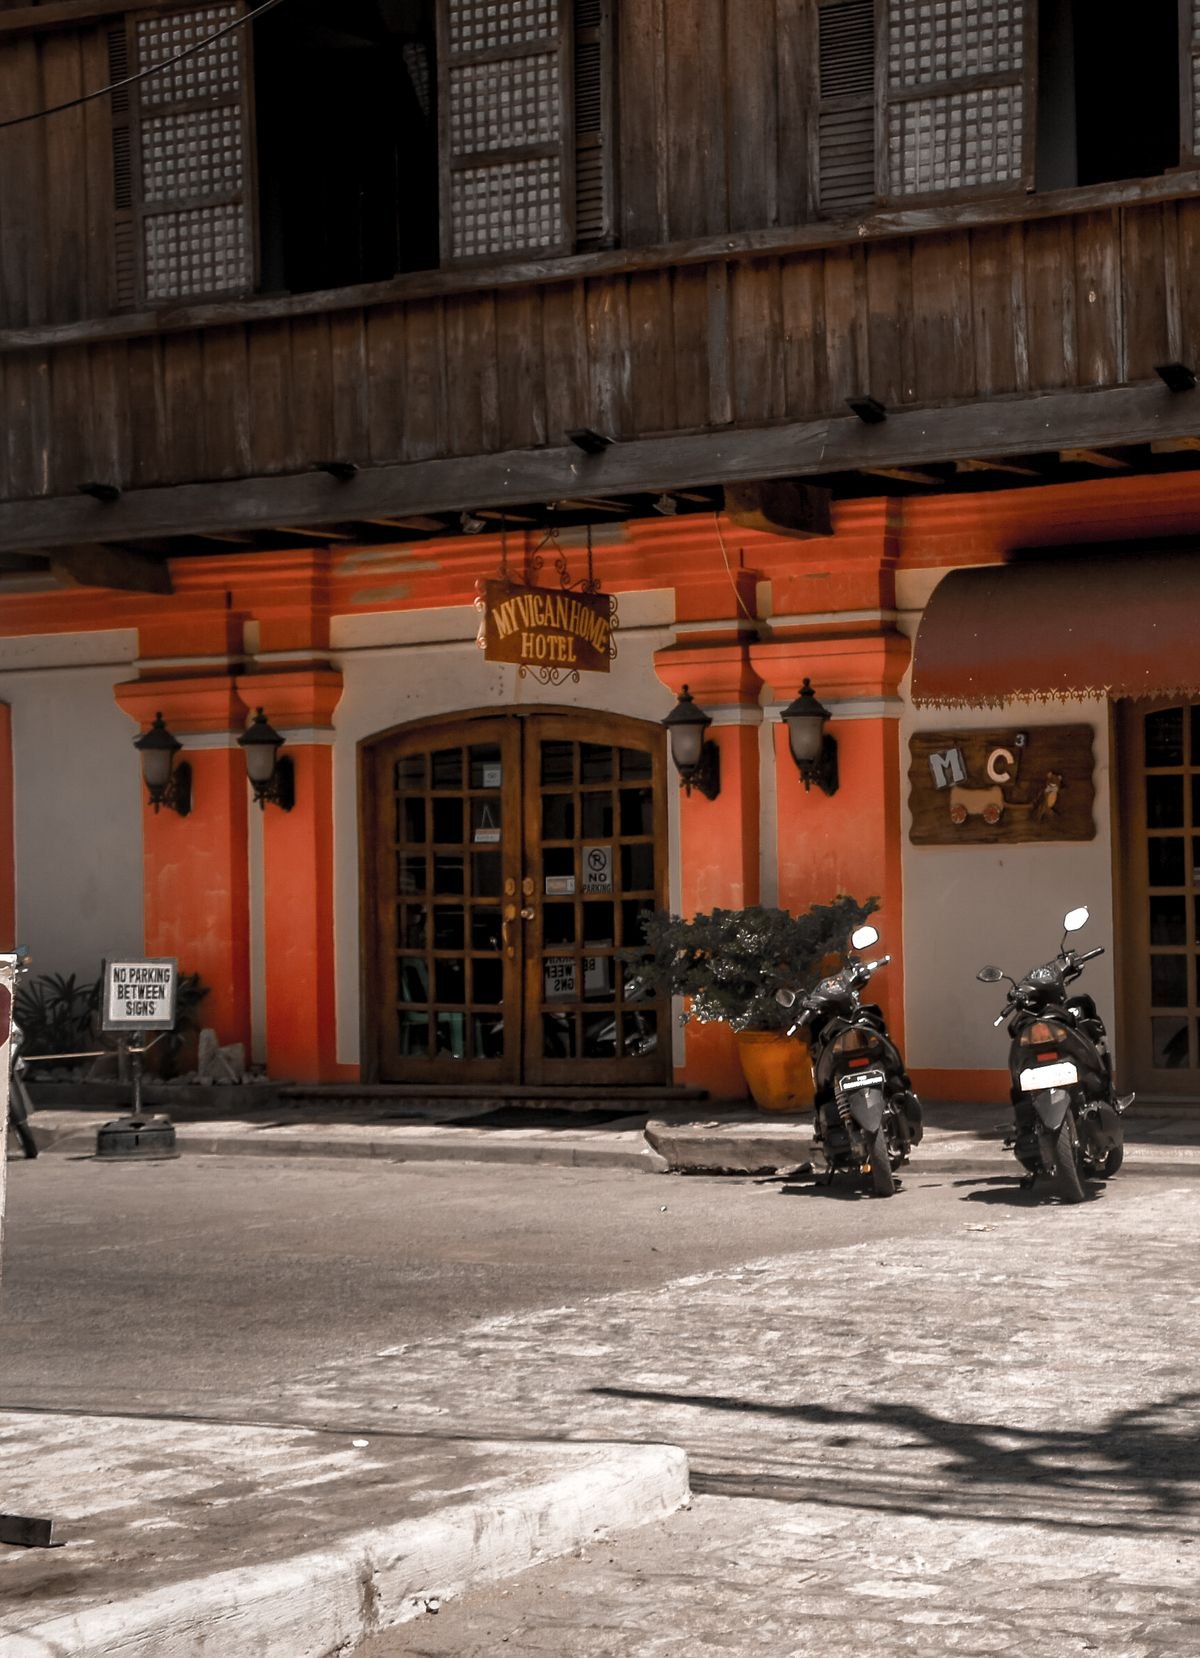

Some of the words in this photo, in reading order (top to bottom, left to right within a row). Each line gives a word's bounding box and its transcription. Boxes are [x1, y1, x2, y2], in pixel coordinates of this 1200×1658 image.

[491, 597, 519, 639] MY
[516, 594, 569, 630] VIGAN
[568, 600, 610, 653] HOME
[521, 632, 577, 662] HOTEL
[588, 873, 607, 883] NO
[113, 967, 127, 983] NO
[129, 967, 171, 983] PARKING
[117, 984, 165, 1000] BETWEEN
[125, 1000, 155, 1016] SIGNS
